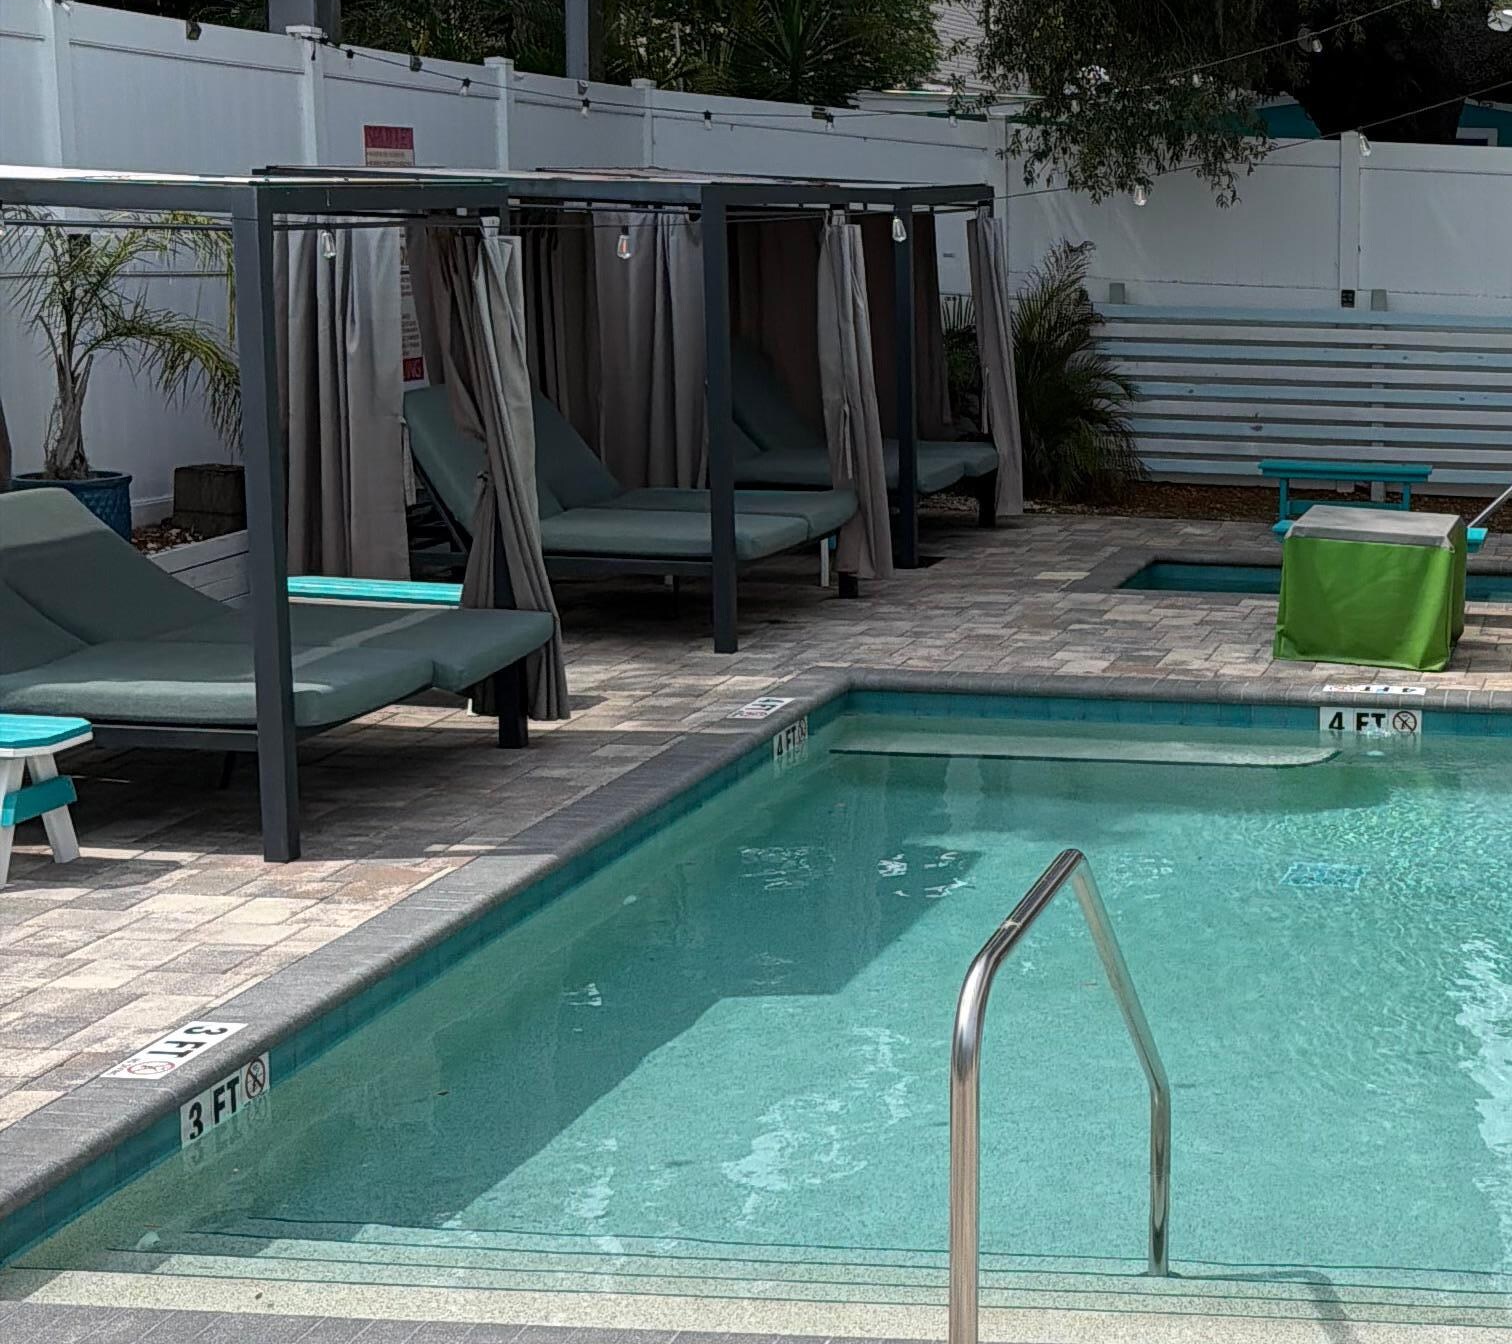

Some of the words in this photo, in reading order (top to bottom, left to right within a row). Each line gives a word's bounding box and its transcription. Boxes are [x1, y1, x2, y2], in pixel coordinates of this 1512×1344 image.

[1329, 711, 1345, 731] 4
[1356, 712, 1386, 731] FT
[777, 734, 784, 756] 4
[785, 725, 797, 752] FT
[184, 1026, 228, 1036] 3
[148, 1040, 207, 1058] FT
[189, 1102, 204, 1140] 3
[213, 1076, 240, 1124] FT
